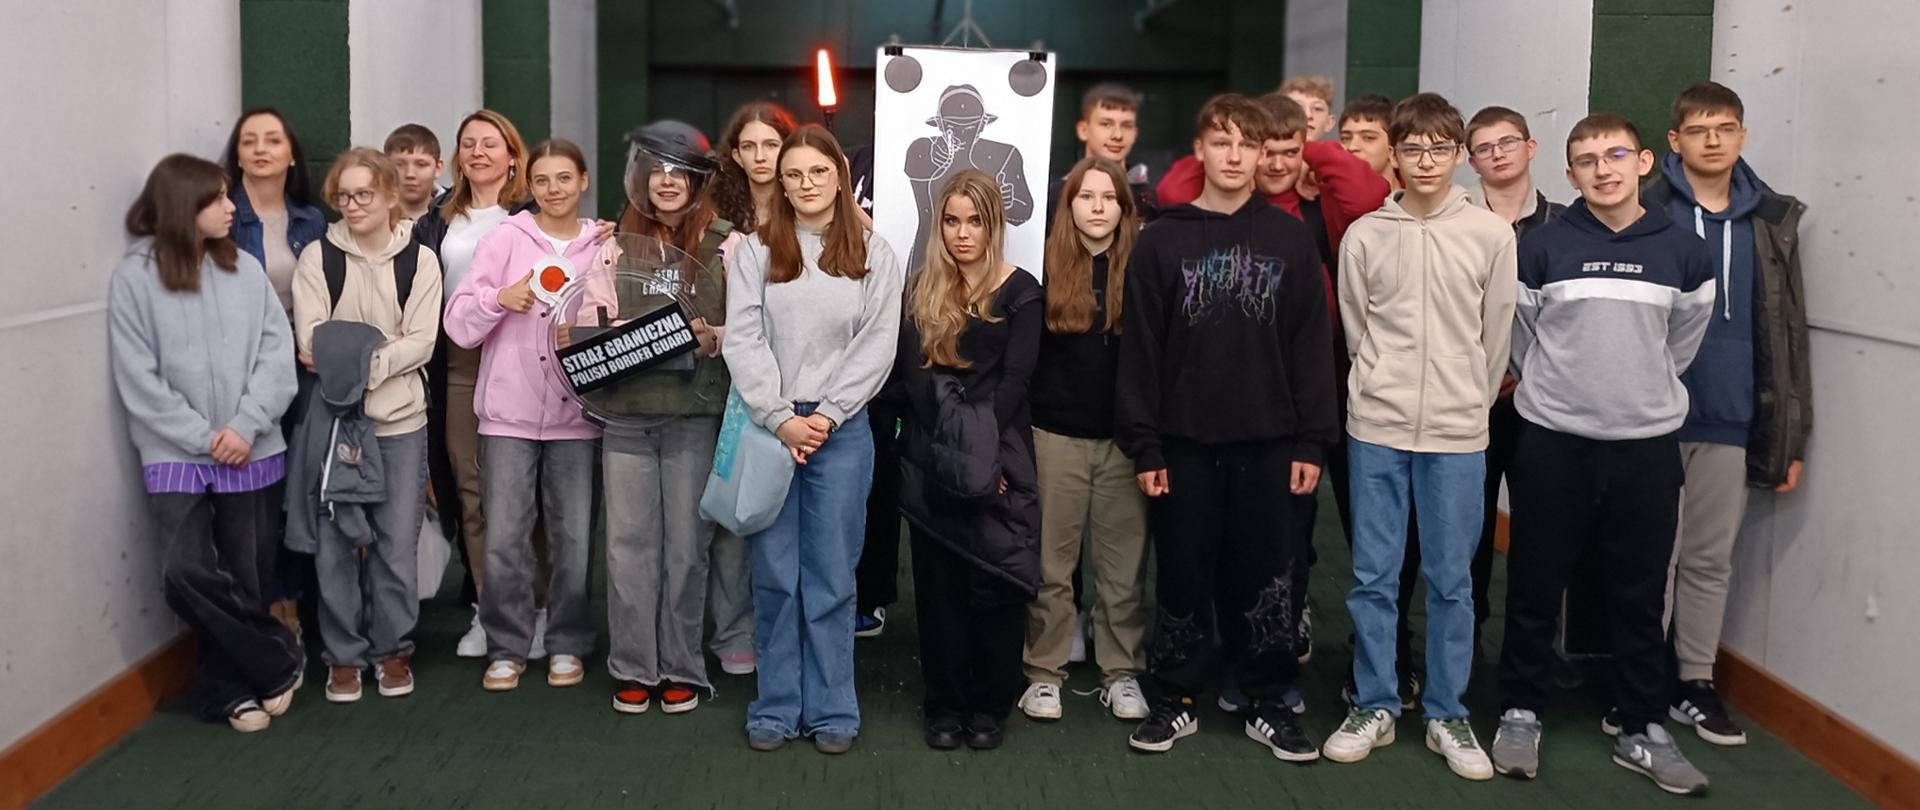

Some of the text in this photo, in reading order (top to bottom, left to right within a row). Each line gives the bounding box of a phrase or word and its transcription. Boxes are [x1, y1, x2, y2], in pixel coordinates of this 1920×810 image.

[1582, 261, 1611, 272] EST
[562, 312, 686, 373] STRAŻ GRANICZNA
[570, 328, 693, 387] POLISH BORDER GUARD
